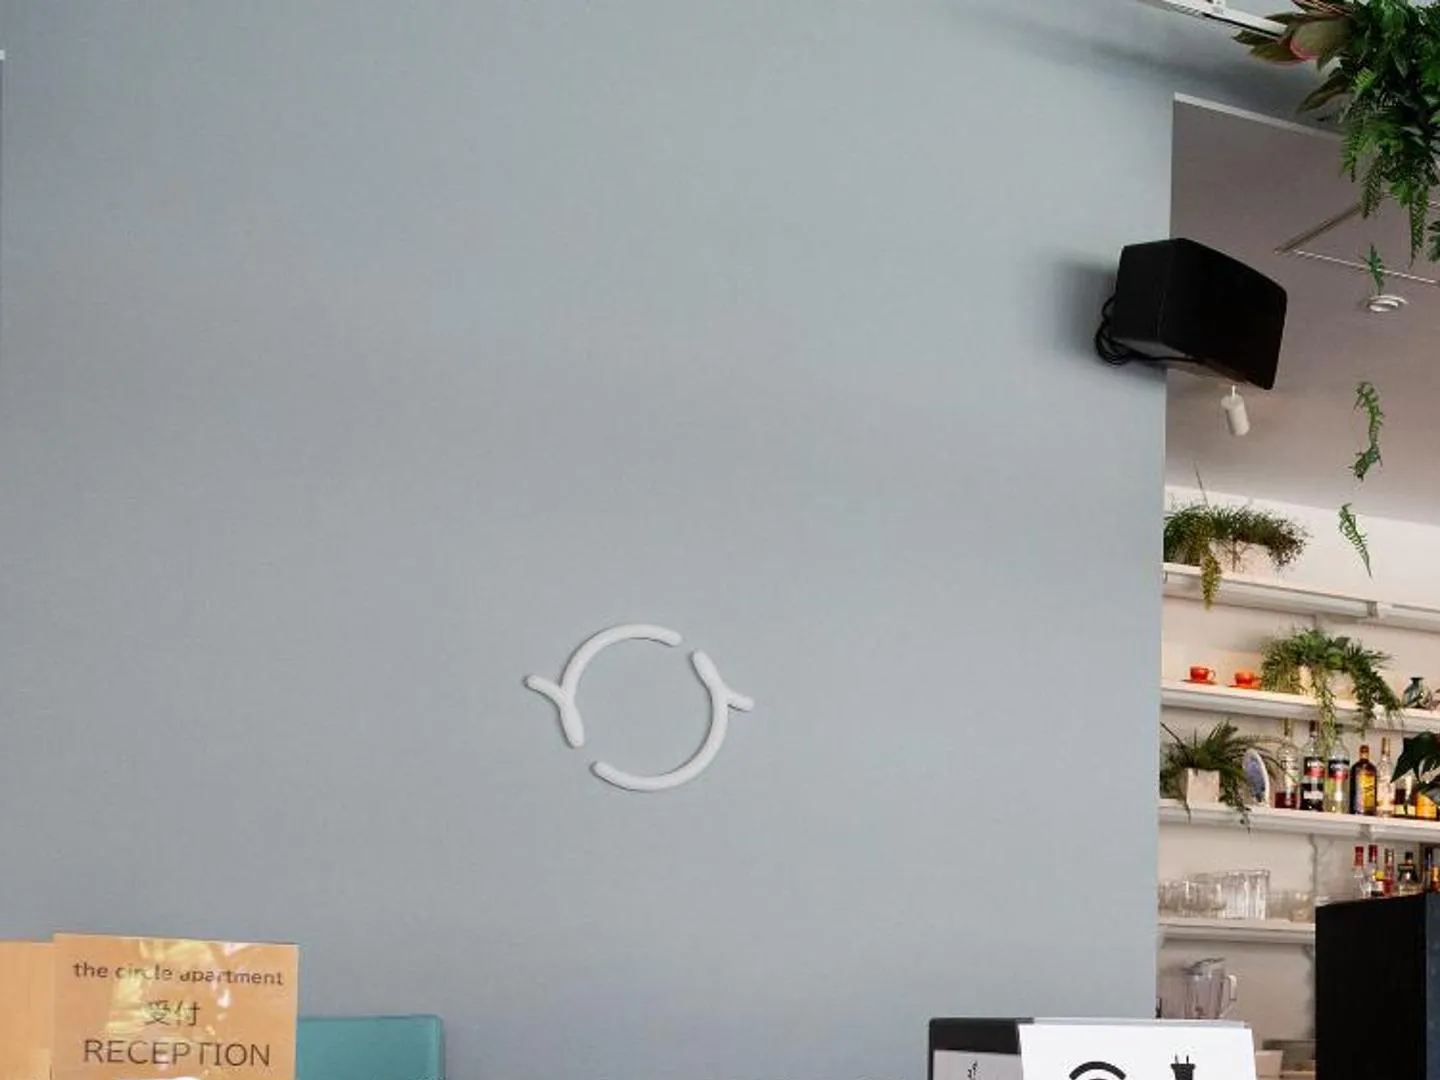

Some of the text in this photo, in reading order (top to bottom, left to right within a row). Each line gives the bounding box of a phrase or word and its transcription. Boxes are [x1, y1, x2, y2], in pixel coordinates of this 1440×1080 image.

[73, 961, 108, 978] the
[115, 964, 172, 981] cirle
[145, 1000, 201, 1027] 受付
[83, 1038, 270, 1066] RECEPTION
